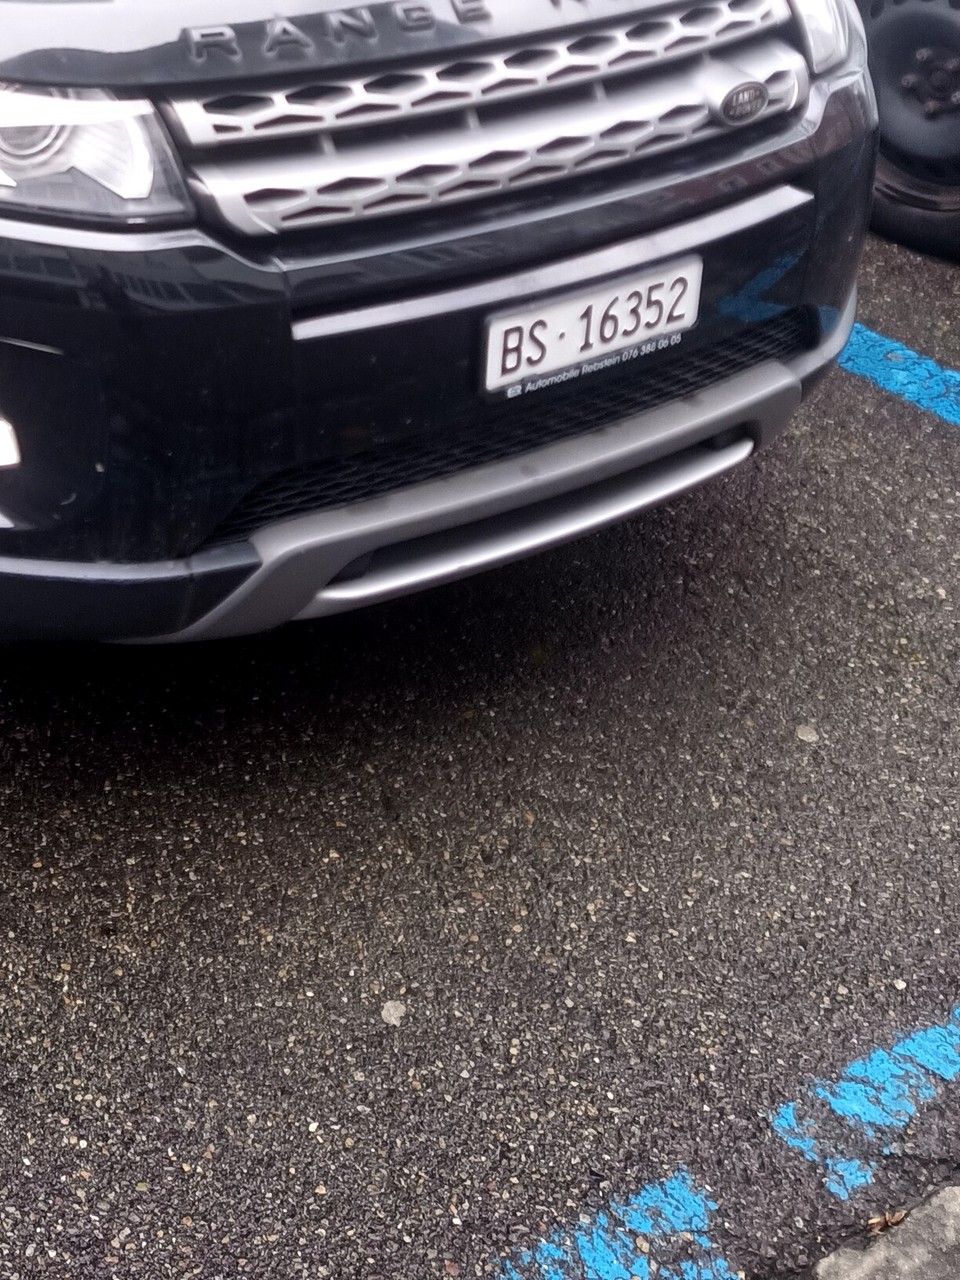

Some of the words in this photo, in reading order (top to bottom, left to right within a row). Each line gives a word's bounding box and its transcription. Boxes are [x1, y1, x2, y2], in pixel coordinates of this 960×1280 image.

[501, 320, 547, 375] BS
[579, 276, 688, 352] 16352
[525, 369, 581, 393] Automobile
[581, 355, 621, 376] Rebstein
[622, 348, 639, 361] 076
[658, 338, 669, 350] 06
